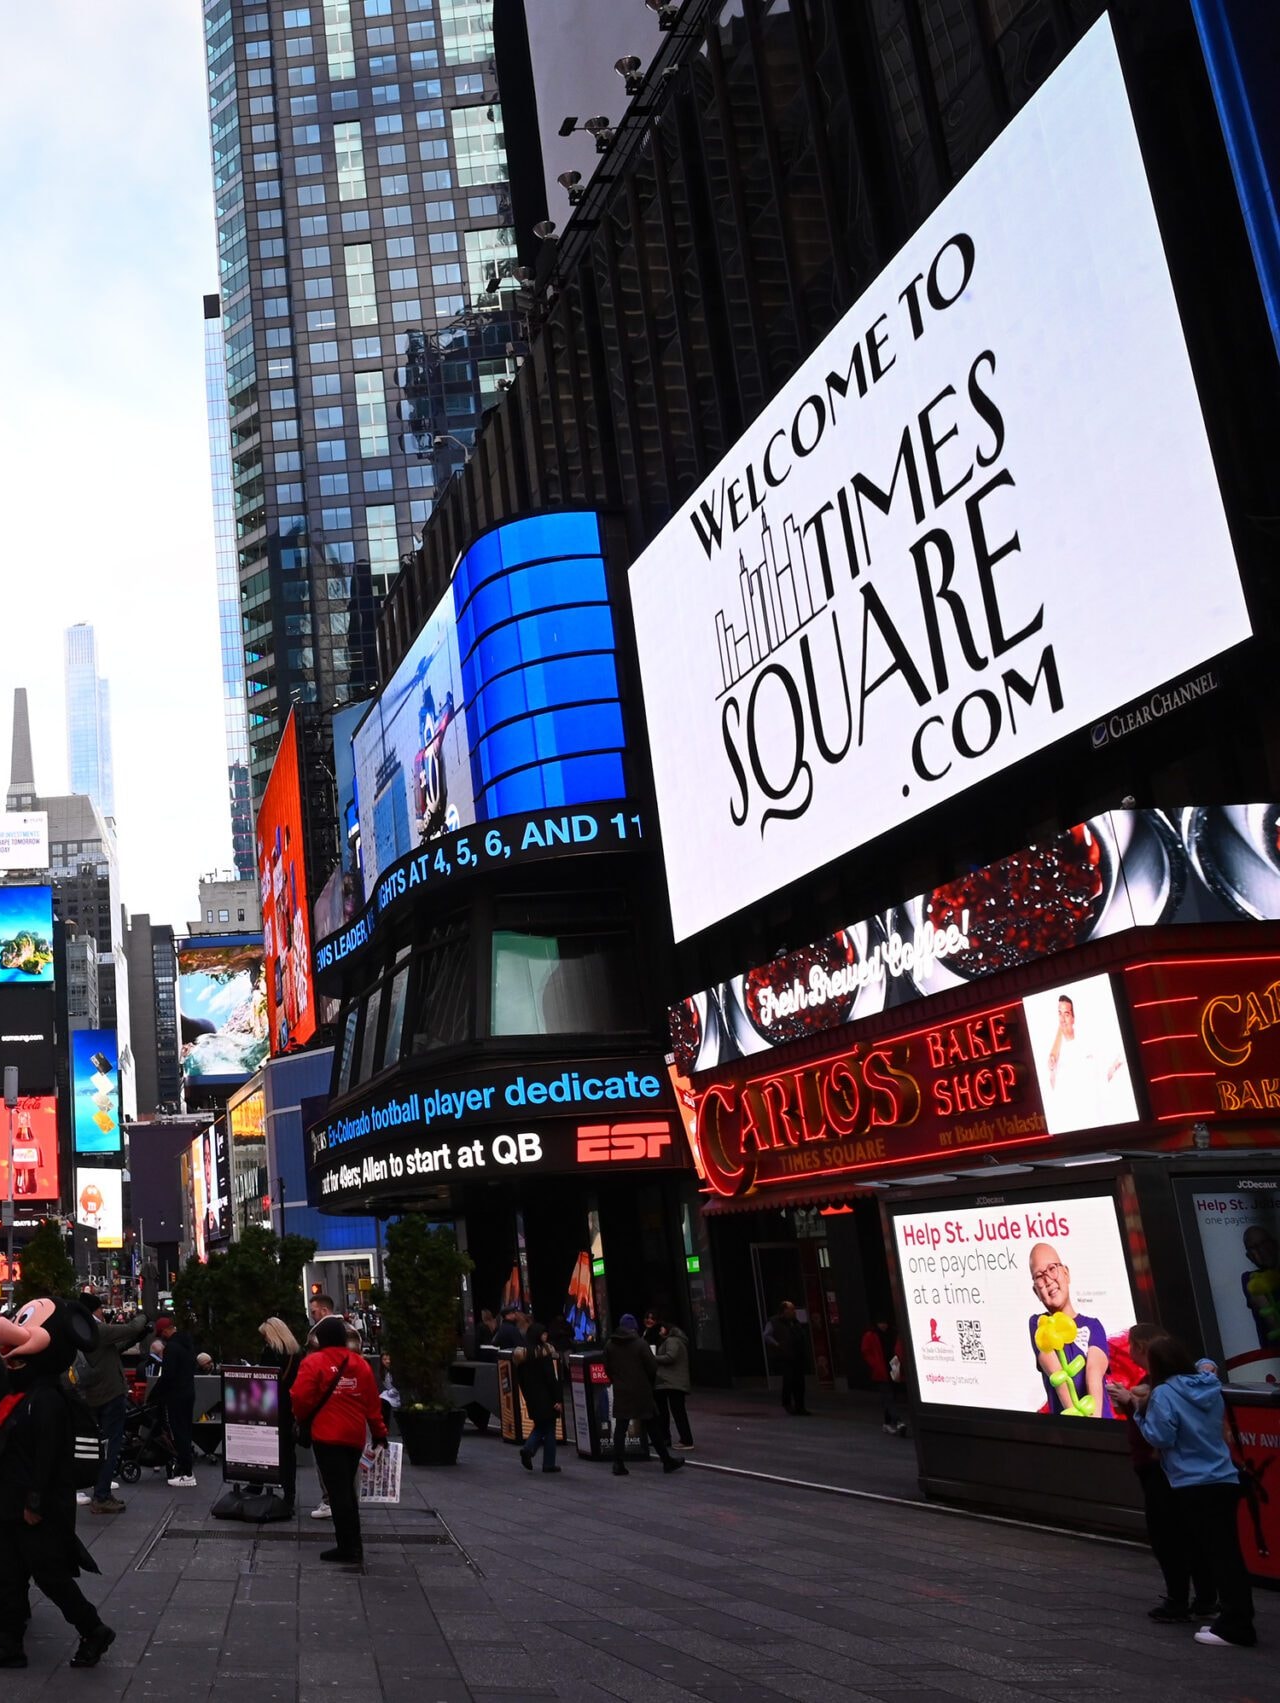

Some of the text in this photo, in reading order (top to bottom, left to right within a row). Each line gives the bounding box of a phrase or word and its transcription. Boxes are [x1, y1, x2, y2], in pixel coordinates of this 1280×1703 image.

[688, 233, 976, 561] WELCOME TO
[800, 349, 1005, 602] TIMES
[720, 468, 1045, 841] SQUARE
[902, 644, 1064, 798] .COM
[410, 857, 429, 888] AT
[433, 851, 451, 876] 4,
[457, 838, 478, 867] 5,
[485, 829, 511, 859] 6,
[521, 814, 599, 850] AND
[758, 909, 970, 1026] Fresh Brewed Coffee!
[926, 1014, 1011, 1068] BAKE
[328, 1110, 370, 1148] Ex-Colorado
[372, 1093, 420, 1131] football
[424, 1085, 495, 1125] player
[505, 1071, 660, 1107] dedicate
[933, 1064, 1015, 1115] SHOP
[778, 1138, 886, 1172] TIMES SQUARE
[939, 1130, 952, 1146] BY
[954, 1120, 995, 1142] Buddy
[330, 1169, 339, 1193] for
[339, 1164, 362, 1190] 49ers;
[363, 1156, 388, 1184] Allen
[389, 1152, 404, 1178] to
[406, 1143, 452, 1176] start
[457, 1139, 486, 1168] at
[492, 1132, 543, 1166] QB
[1237, 1179, 1278, 1189] JCDecaux
[903, 1212, 1070, 1250] Help St. Jude kids
[1197, 1199, 1226, 1213] Help
[1229, 1199, 1248, 1211] St.
[1205, 1216, 1223, 1225] one
[908, 1247, 1018, 1278] one paycheck
[914, 1283, 985, 1304] at a time.
[224, 1371, 278, 1380] MIDNIGHT MOMENT
